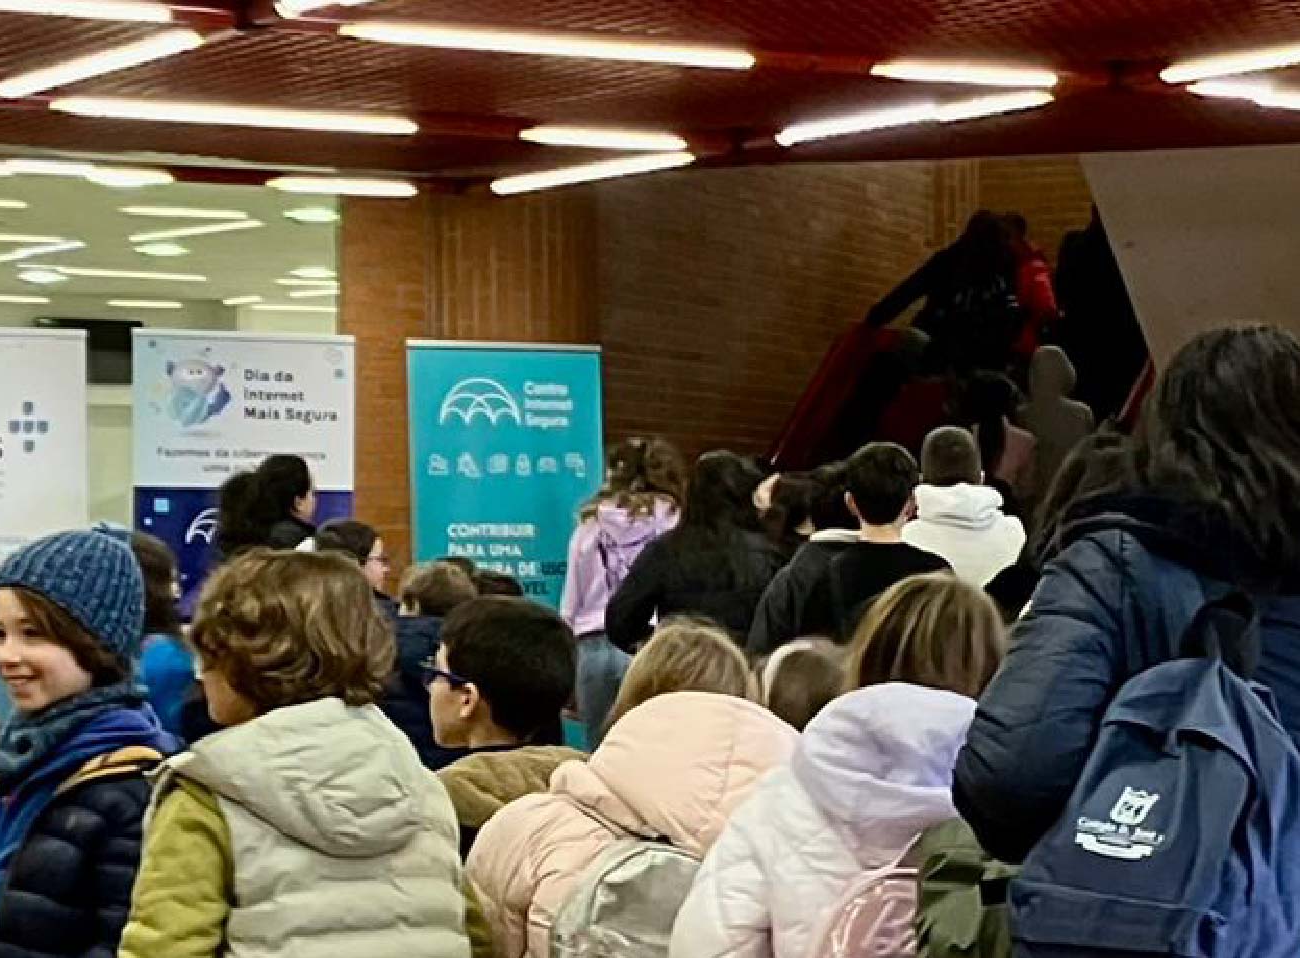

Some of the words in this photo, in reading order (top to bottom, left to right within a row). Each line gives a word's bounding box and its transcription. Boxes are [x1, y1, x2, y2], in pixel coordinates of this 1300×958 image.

[243, 368, 270, 381] Dia
[274, 370, 293, 383] da
[243, 405, 280, 420] Mais
[284, 407, 338, 425] Segura
